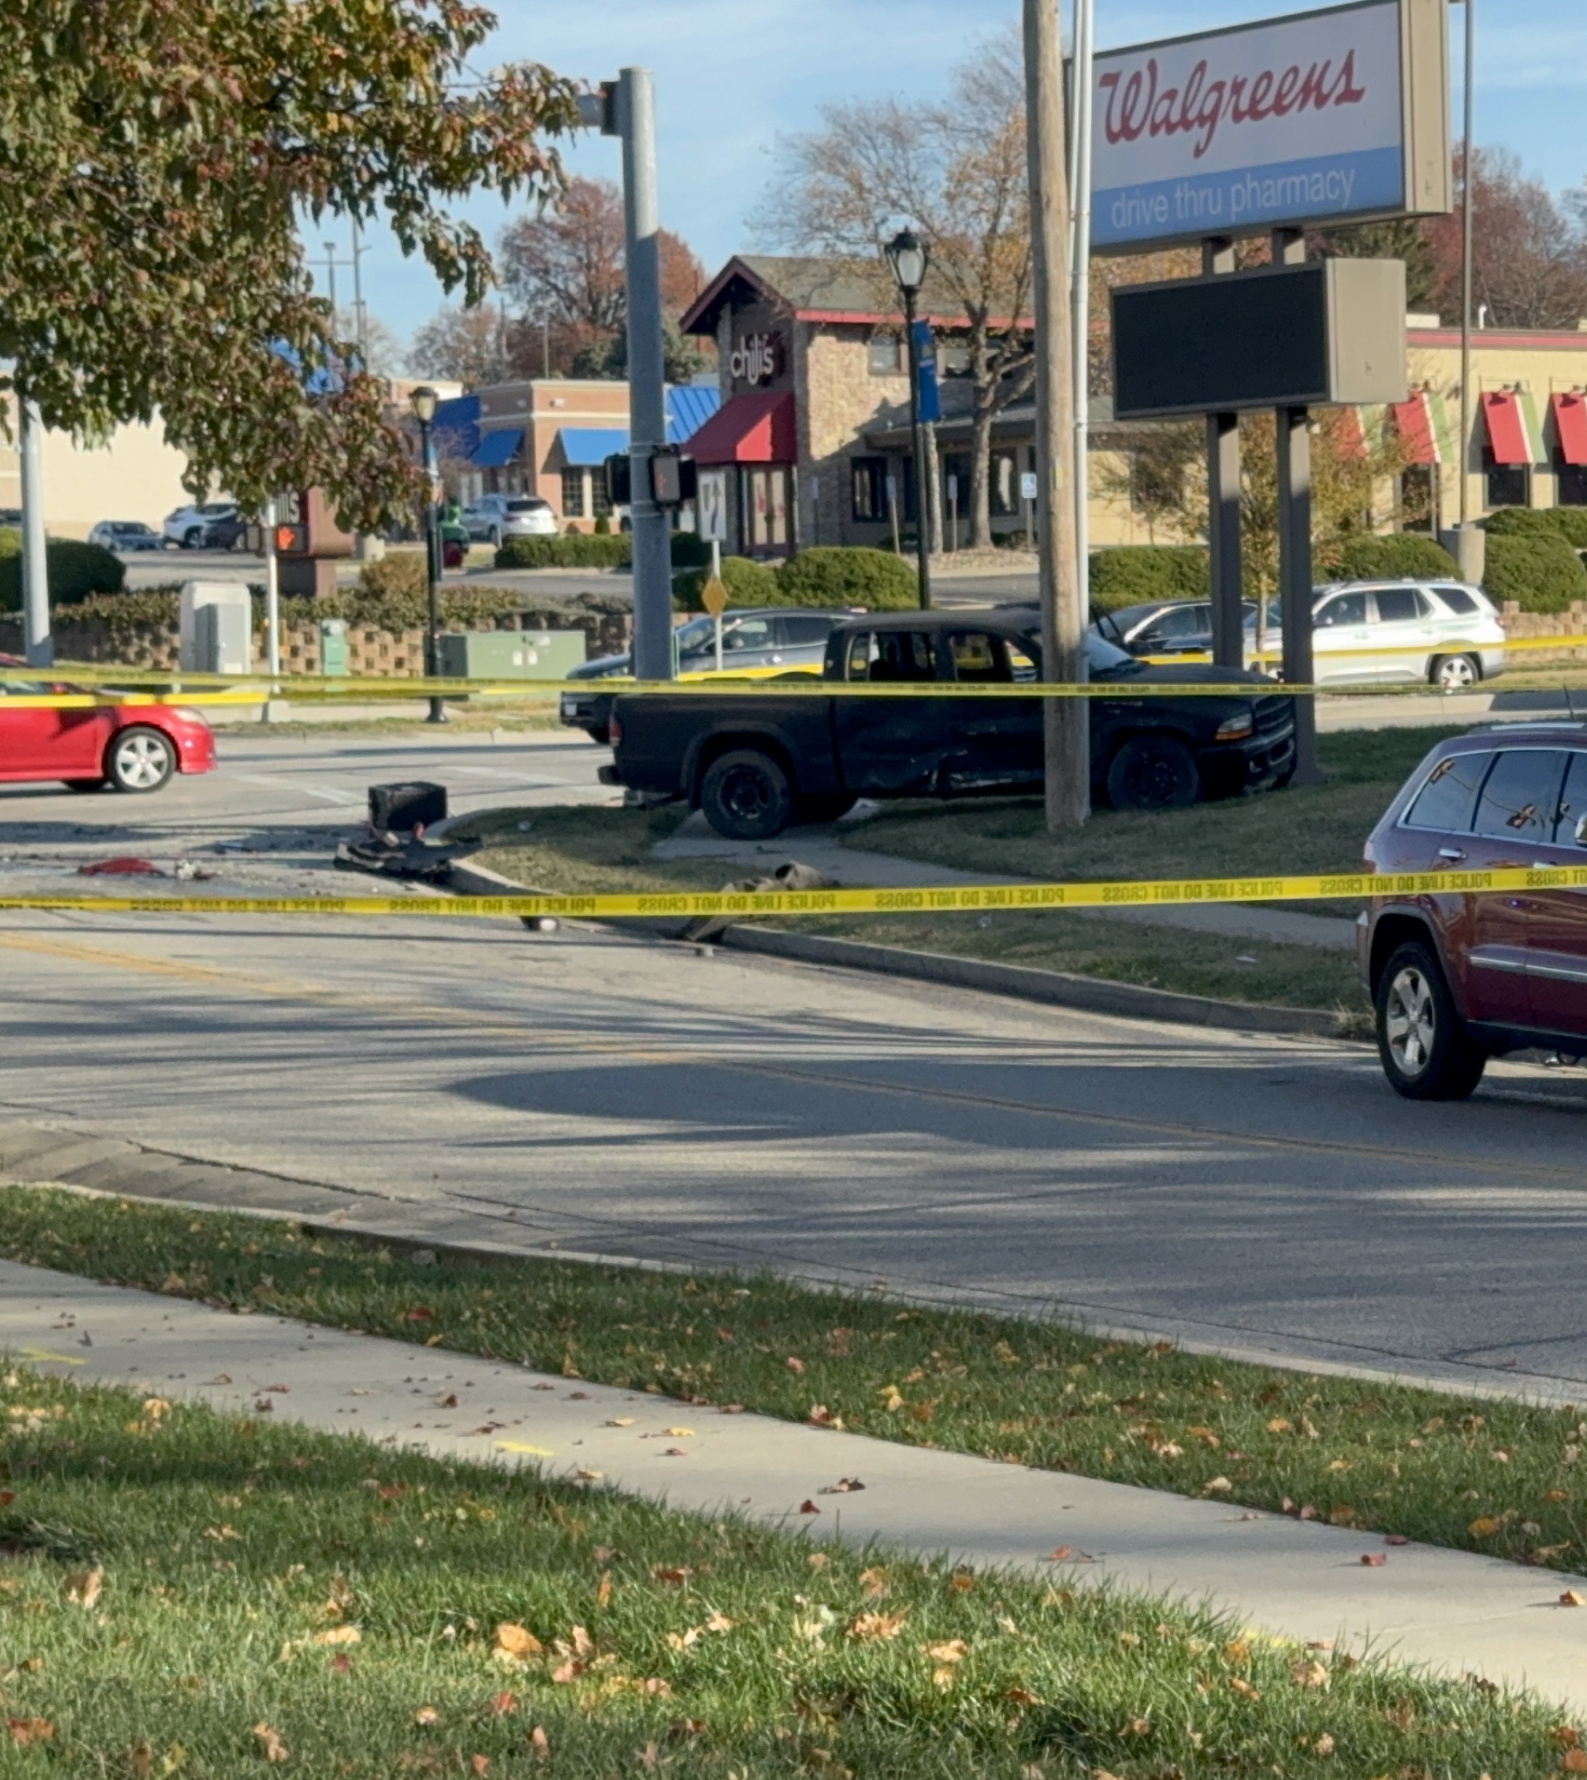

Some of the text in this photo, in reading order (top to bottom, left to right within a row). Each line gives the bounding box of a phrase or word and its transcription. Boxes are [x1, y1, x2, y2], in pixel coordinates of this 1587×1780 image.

[1099, 48, 1366, 160] Walgreens
[1111, 166, 1356, 229] drive thru pharmacy
